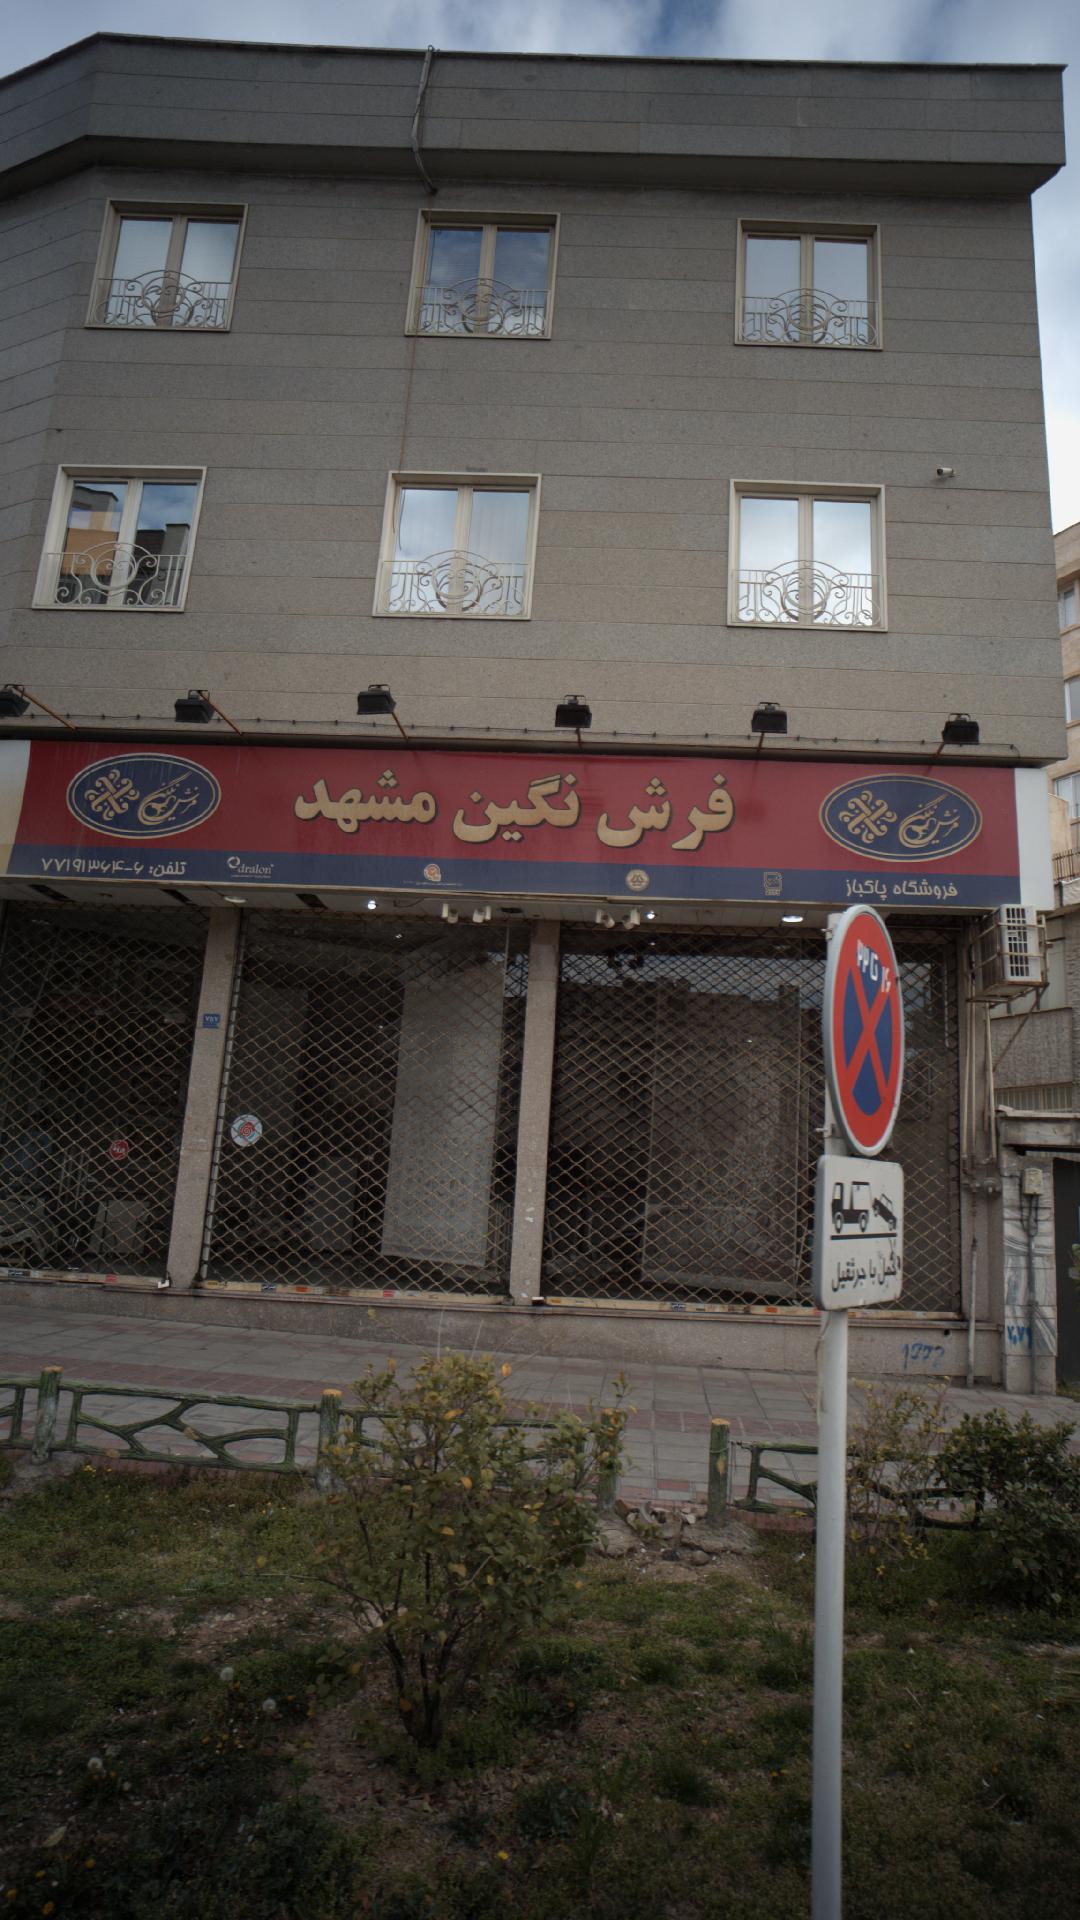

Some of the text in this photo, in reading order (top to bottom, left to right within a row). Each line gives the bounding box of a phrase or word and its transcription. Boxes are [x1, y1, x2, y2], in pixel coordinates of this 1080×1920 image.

[294, 768, 735, 850] فرش نگین مشهد
[149, 861, 188, 878] تلفن:
[237, 863, 272, 875] dralon
[845, 878, 959, 901] فروشگاه پاکباز
[832, 1257, 866, 1293] جرثقیل
[869, 1258, 877, 1286] با
